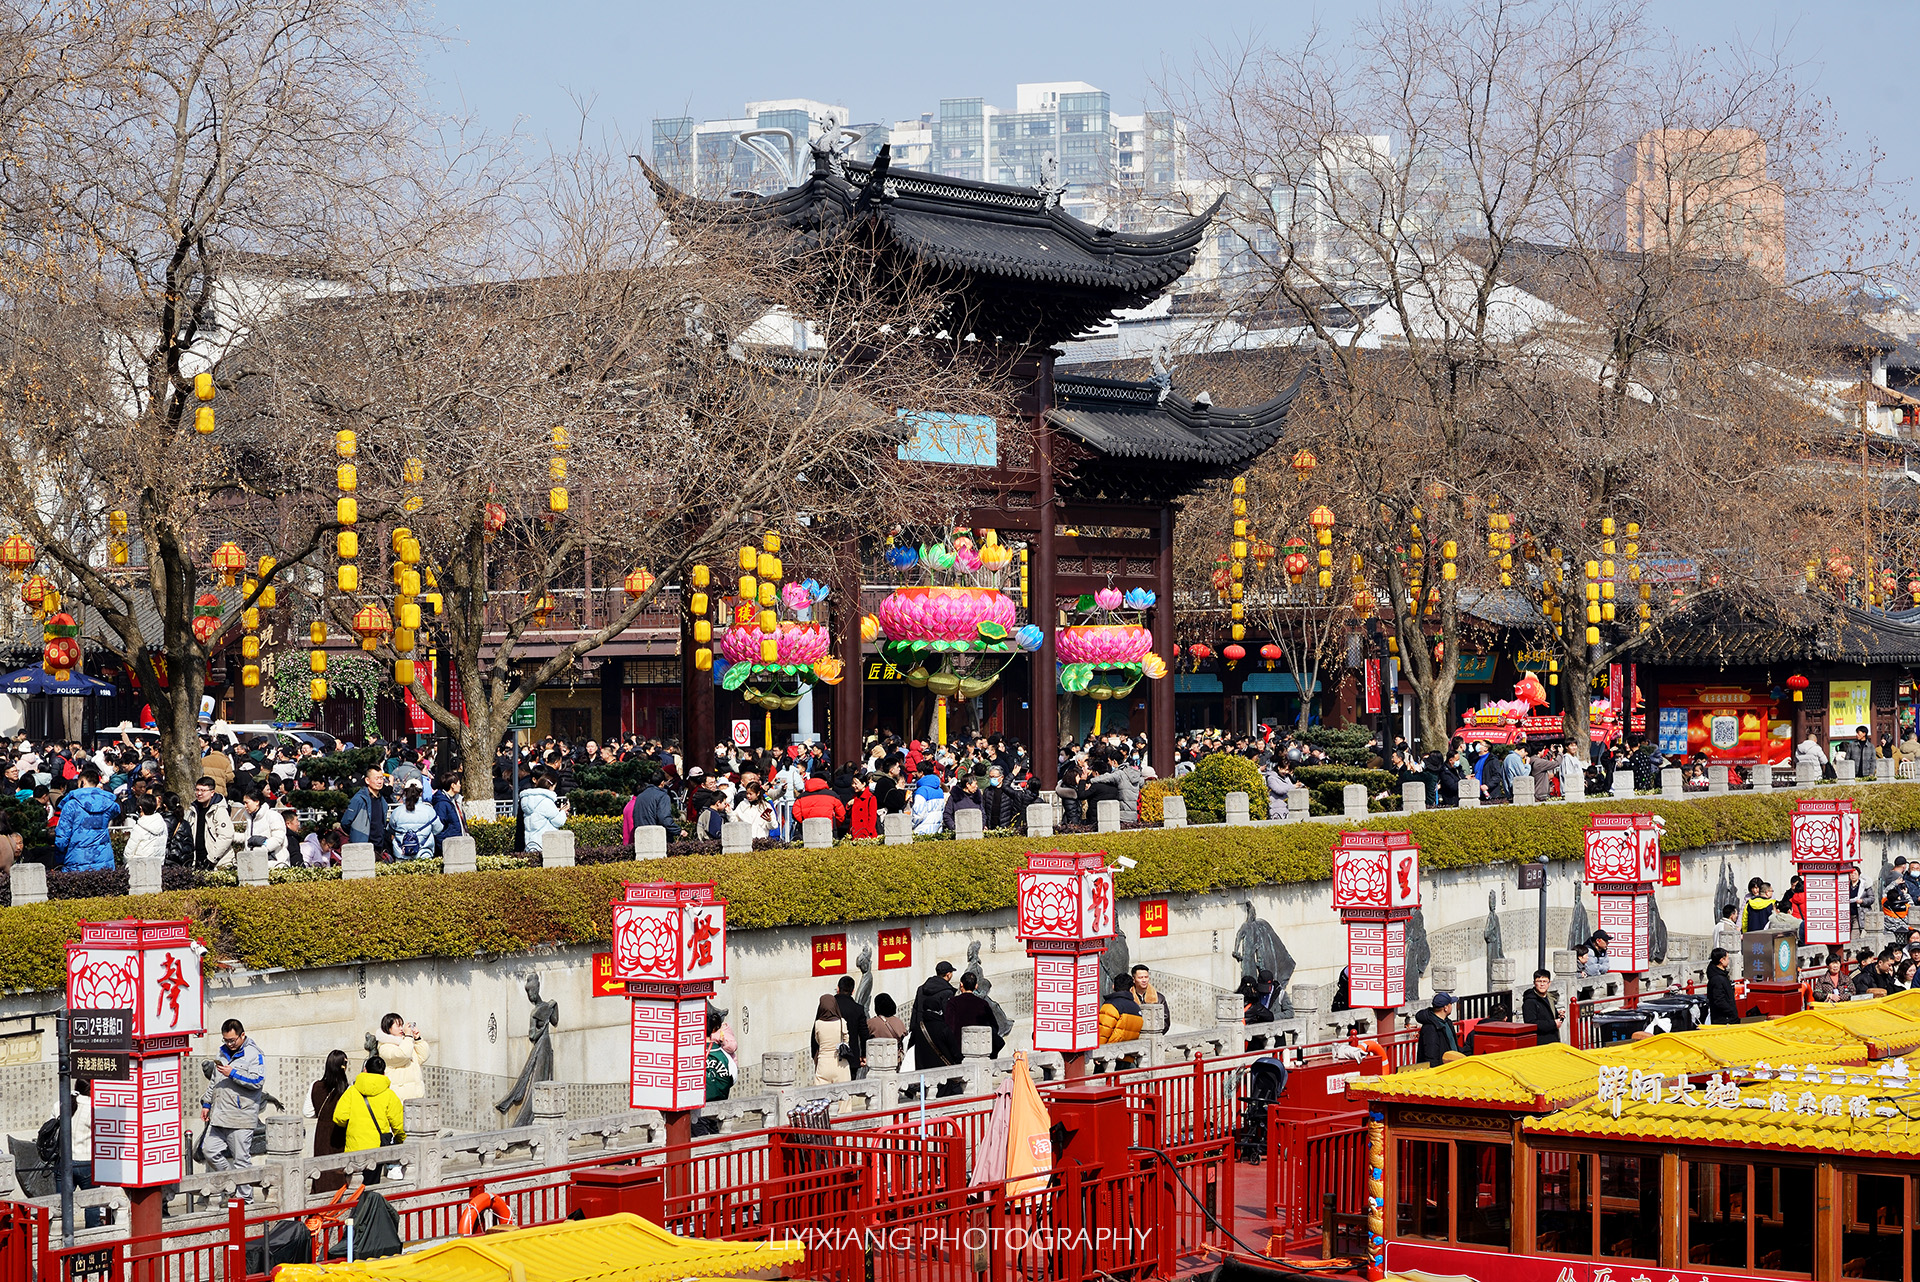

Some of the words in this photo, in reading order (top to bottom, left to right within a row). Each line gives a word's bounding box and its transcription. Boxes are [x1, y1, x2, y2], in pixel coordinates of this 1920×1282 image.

[1665, 858, 1678, 873] 出口
[1145, 903, 1163, 921] 出口
[816, 941, 843, 953] 西线向此
[882, 935, 908, 947] 东线向此
[600, 956, 612, 977] 出
[90, 1017, 123, 1036] 2号登船口
[76, 1056, 118, 1072] 泮池游船码头
